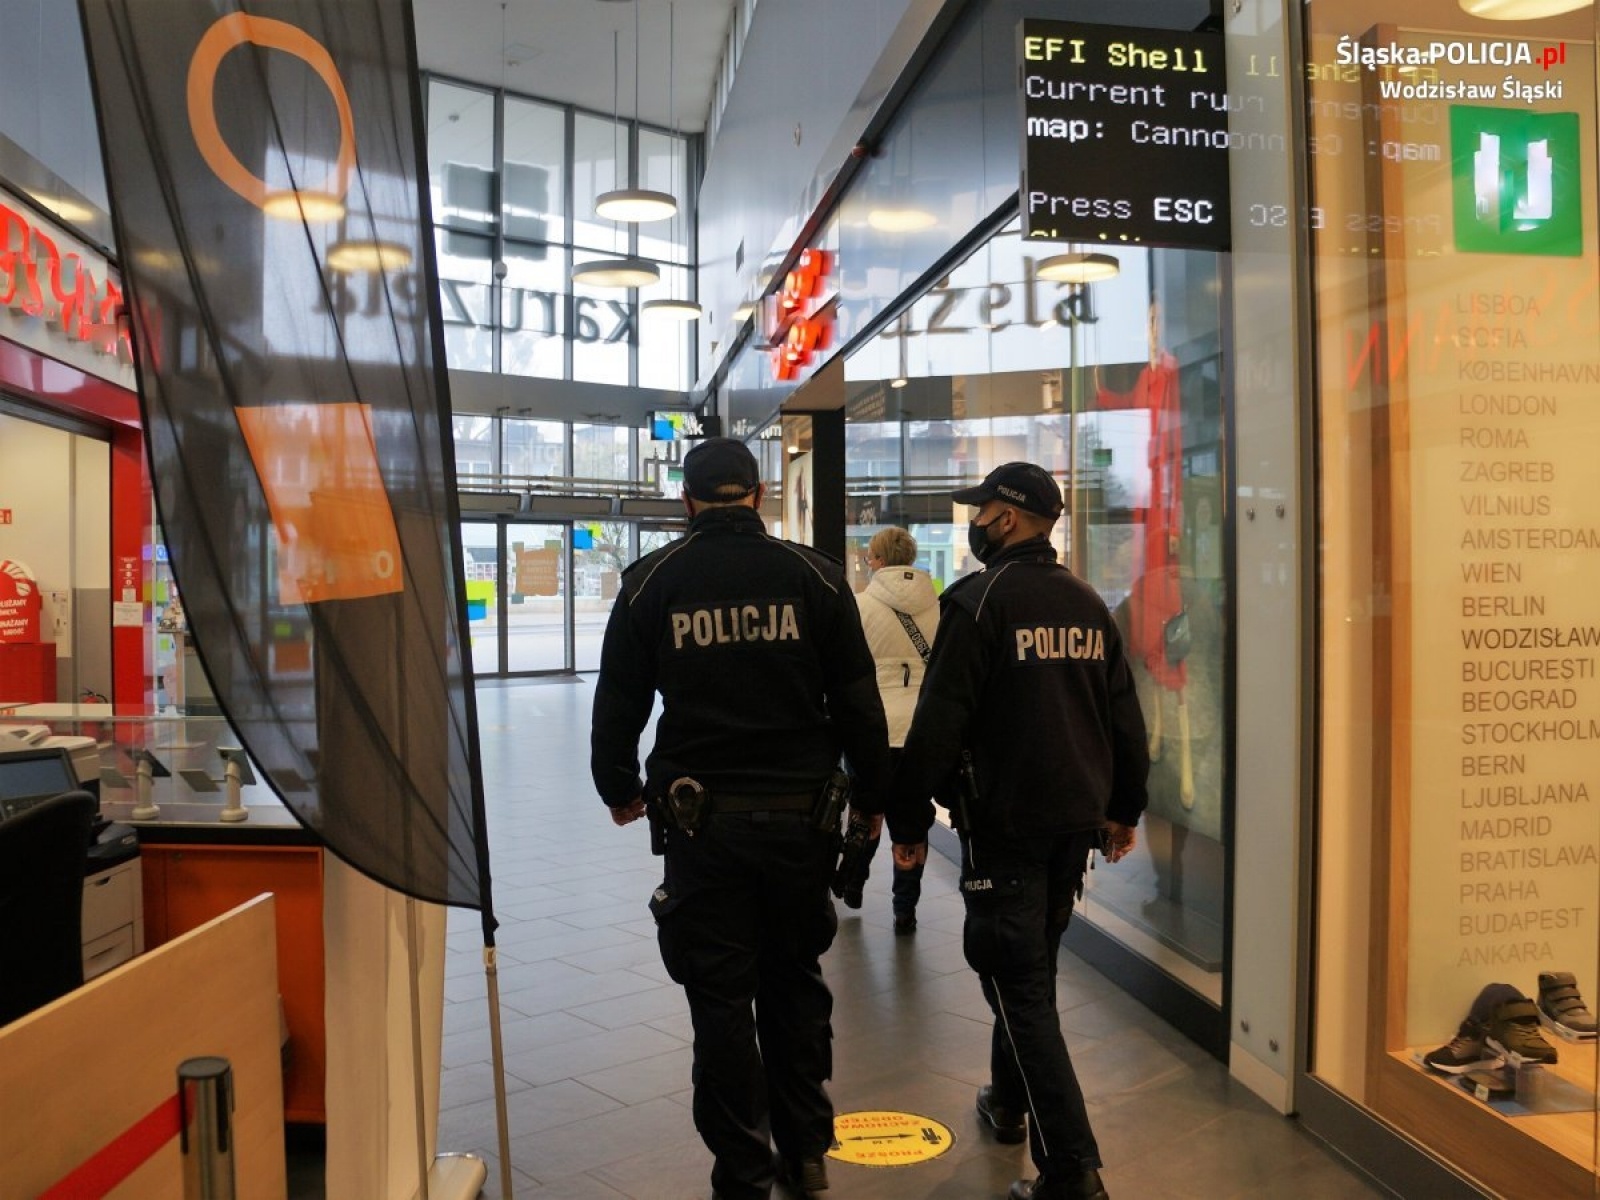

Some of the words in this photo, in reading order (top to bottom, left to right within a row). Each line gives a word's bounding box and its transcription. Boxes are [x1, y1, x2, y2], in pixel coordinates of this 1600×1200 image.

[1024, 36, 1086, 63] EFI
[1107, 42, 1208, 73] Shell
[1026, 75, 1167, 107] Current
[1027, 116, 1104, 143] map:
[1029, 191, 1132, 219] Press
[1154, 197, 1213, 224] ESC
[1456, 295, 1540, 316] LISBOA
[1457, 327, 1527, 349] SOFIA
[1459, 394, 1557, 416] LONDON
[1459, 427, 1530, 449] ROMA
[1459, 461, 1555, 483] ZAGREB
[1460, 495, 1550, 516] VILNIUS
[1461, 562, 1522, 583] WIEN
[1461, 595, 1545, 617] BERLIN
[671, 603, 800, 649] POLICJA
[1461, 627, 1600, 650] WODZISŁAW
[1015, 626, 1105, 661] POLICJA
[1462, 688, 1578, 713] BEOGRAD
[1461, 754, 1526, 777] BERN
[1460, 782, 1590, 809] LJUBLJANA
[1460, 815, 1552, 841] MADRID
[1459, 844, 1597, 872] BRATISLAVA
[1459, 879, 1540, 904] PRAHA
[1458, 907, 1585, 936] BUDAPEST
[1456, 941, 1554, 968] ANKARA
